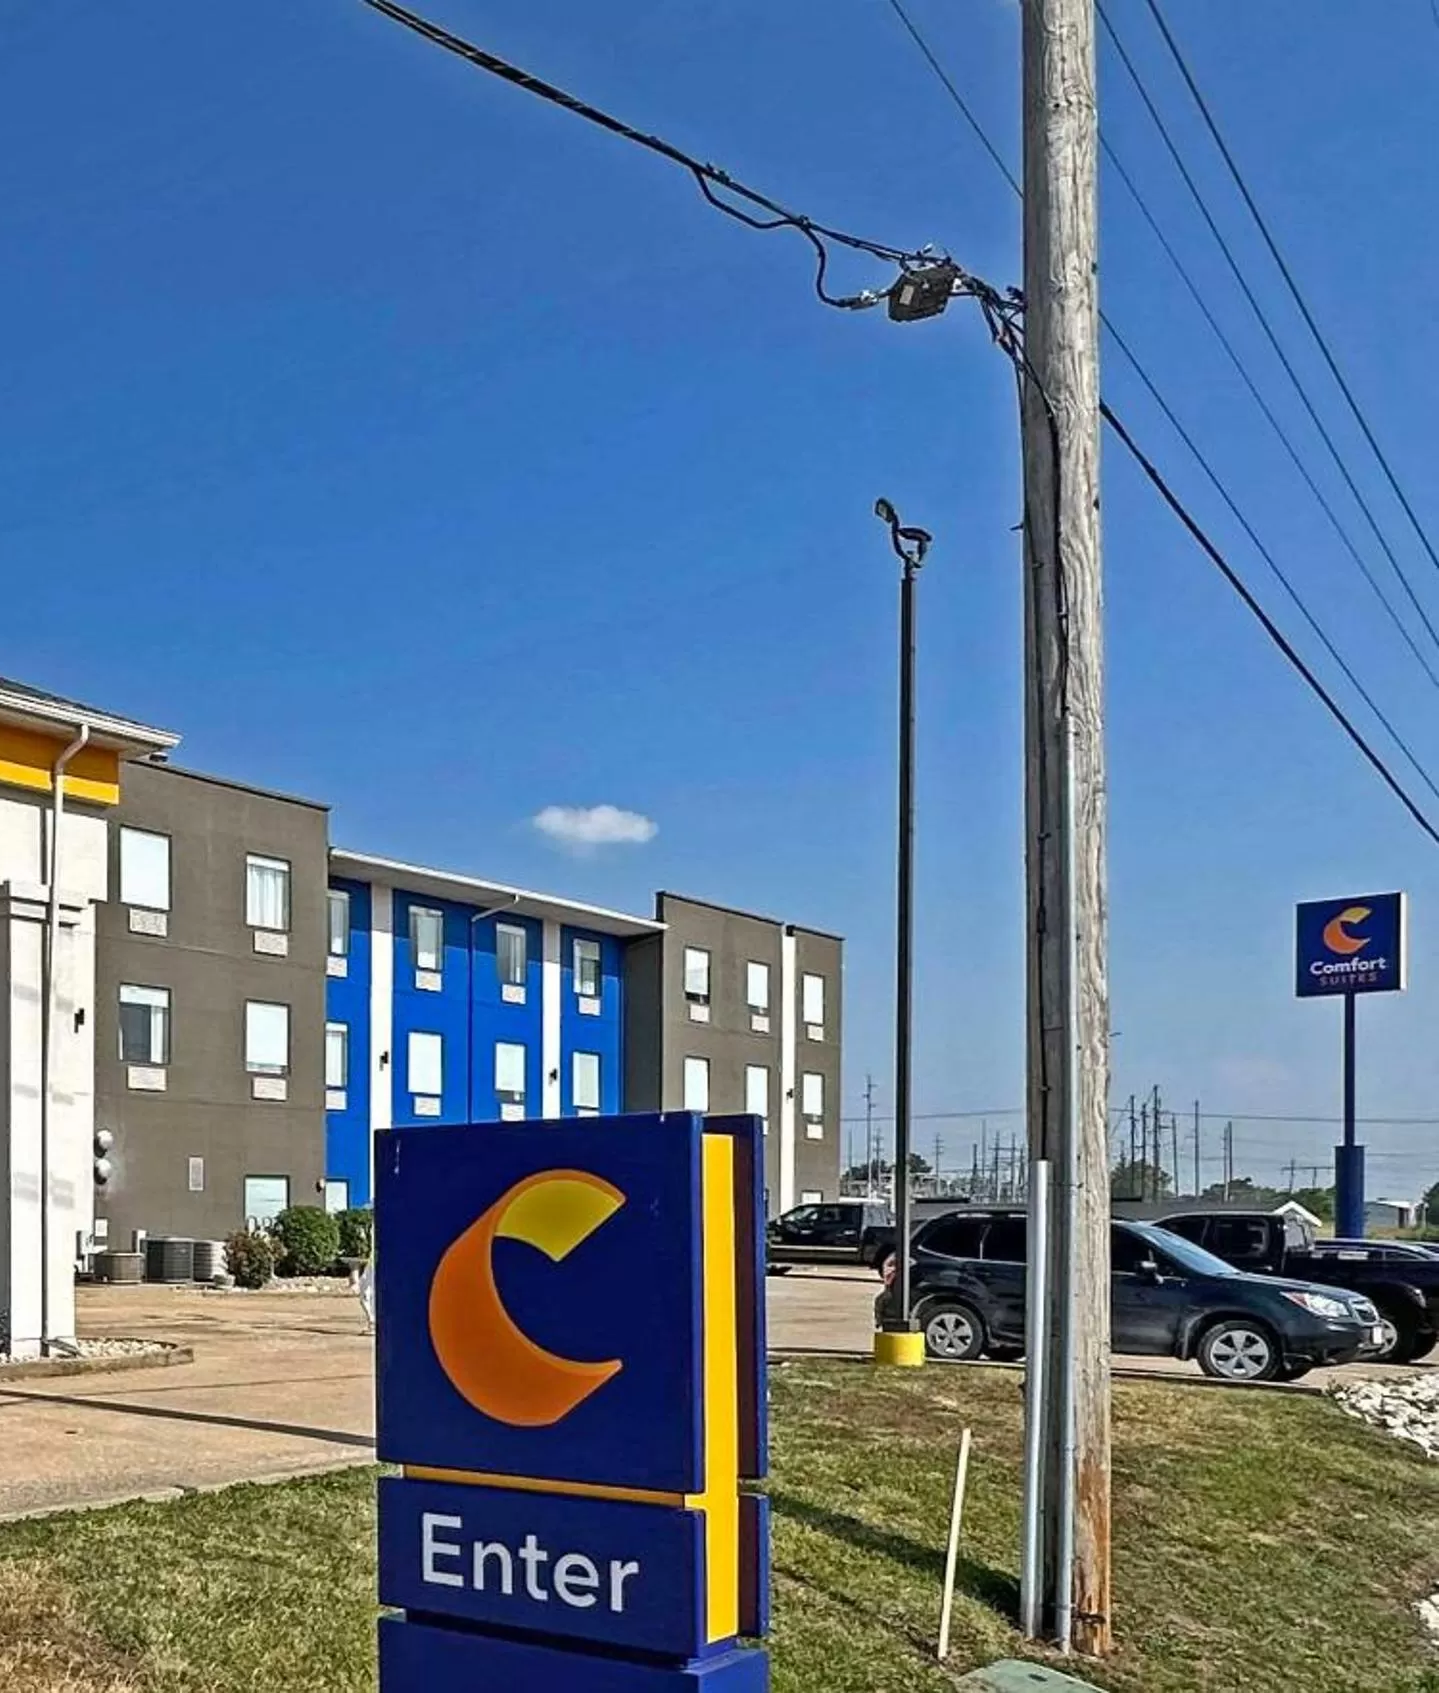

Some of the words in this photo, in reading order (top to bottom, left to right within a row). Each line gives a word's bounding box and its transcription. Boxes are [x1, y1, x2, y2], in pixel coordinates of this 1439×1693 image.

[1310, 957, 1386, 974] Comfort
[1319, 972, 1378, 986] SUITES
[422, 1512, 639, 1612] Enter
